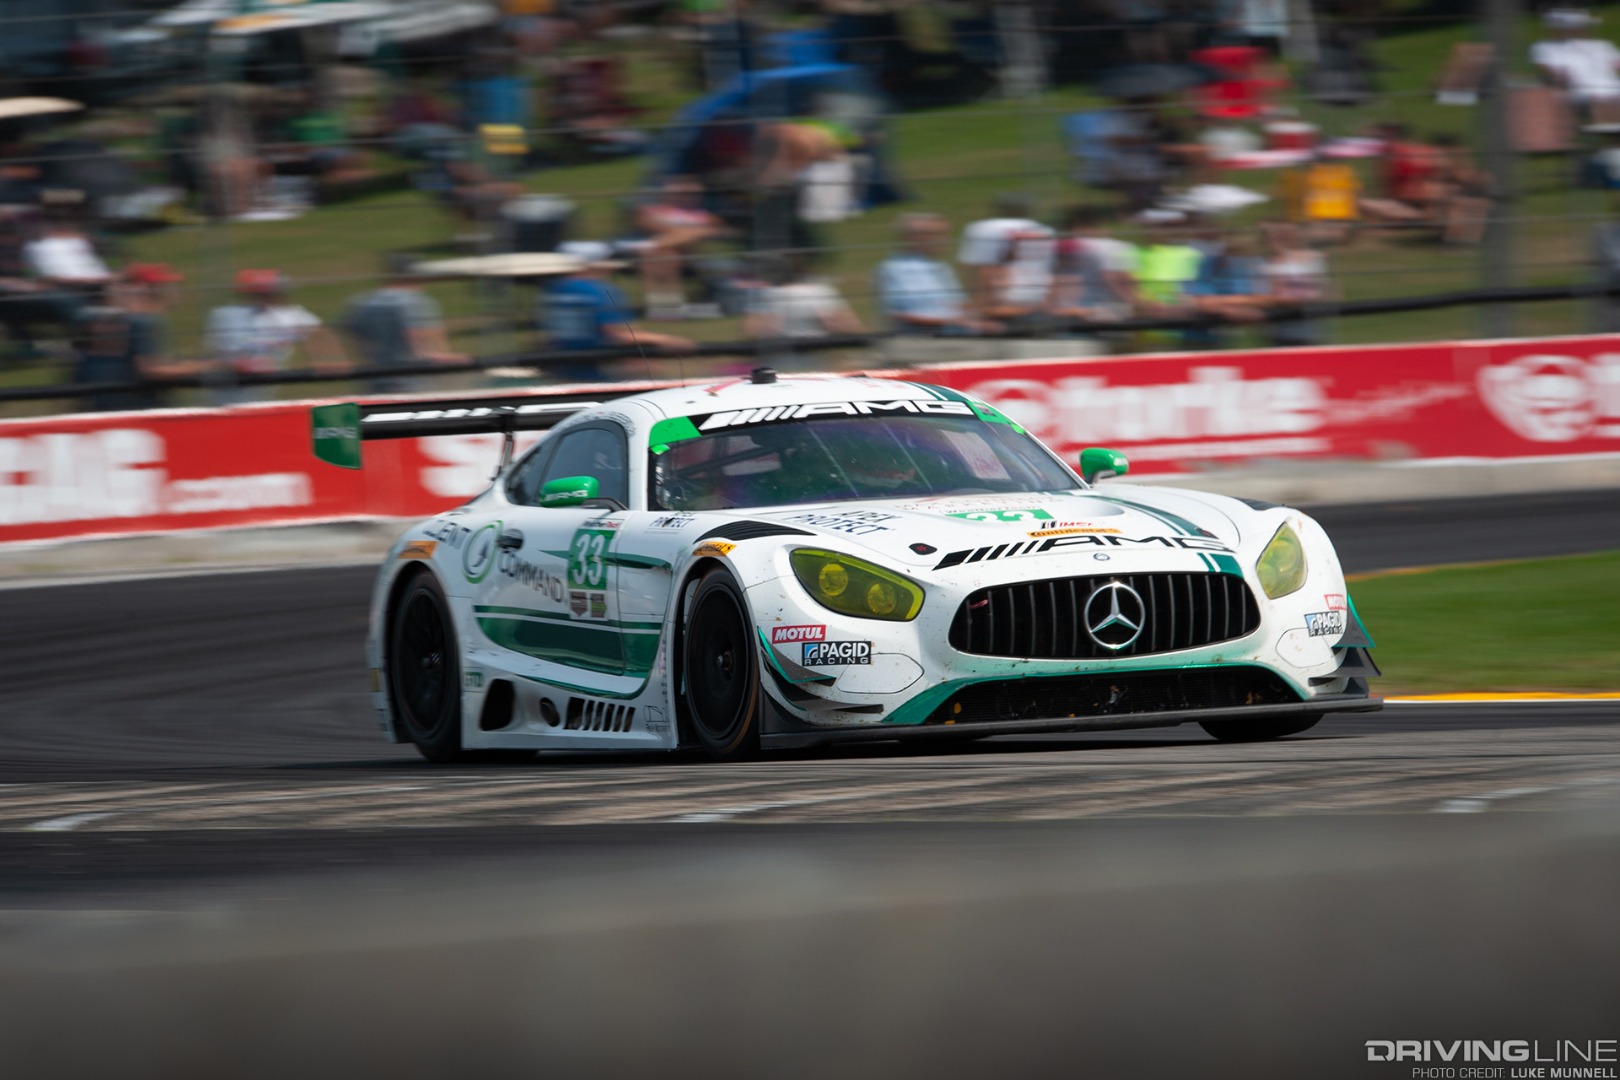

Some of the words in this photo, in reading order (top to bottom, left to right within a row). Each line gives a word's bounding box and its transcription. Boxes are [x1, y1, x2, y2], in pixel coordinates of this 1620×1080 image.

[1036, 535, 1239, 554] AMG
[572, 533, 606, 586] 33
[497, 548, 564, 603] COMMAND
[774, 626, 824, 641] MOTUL
[820, 642, 869, 658] PAGID
[804, 657, 869, 666] RACING
